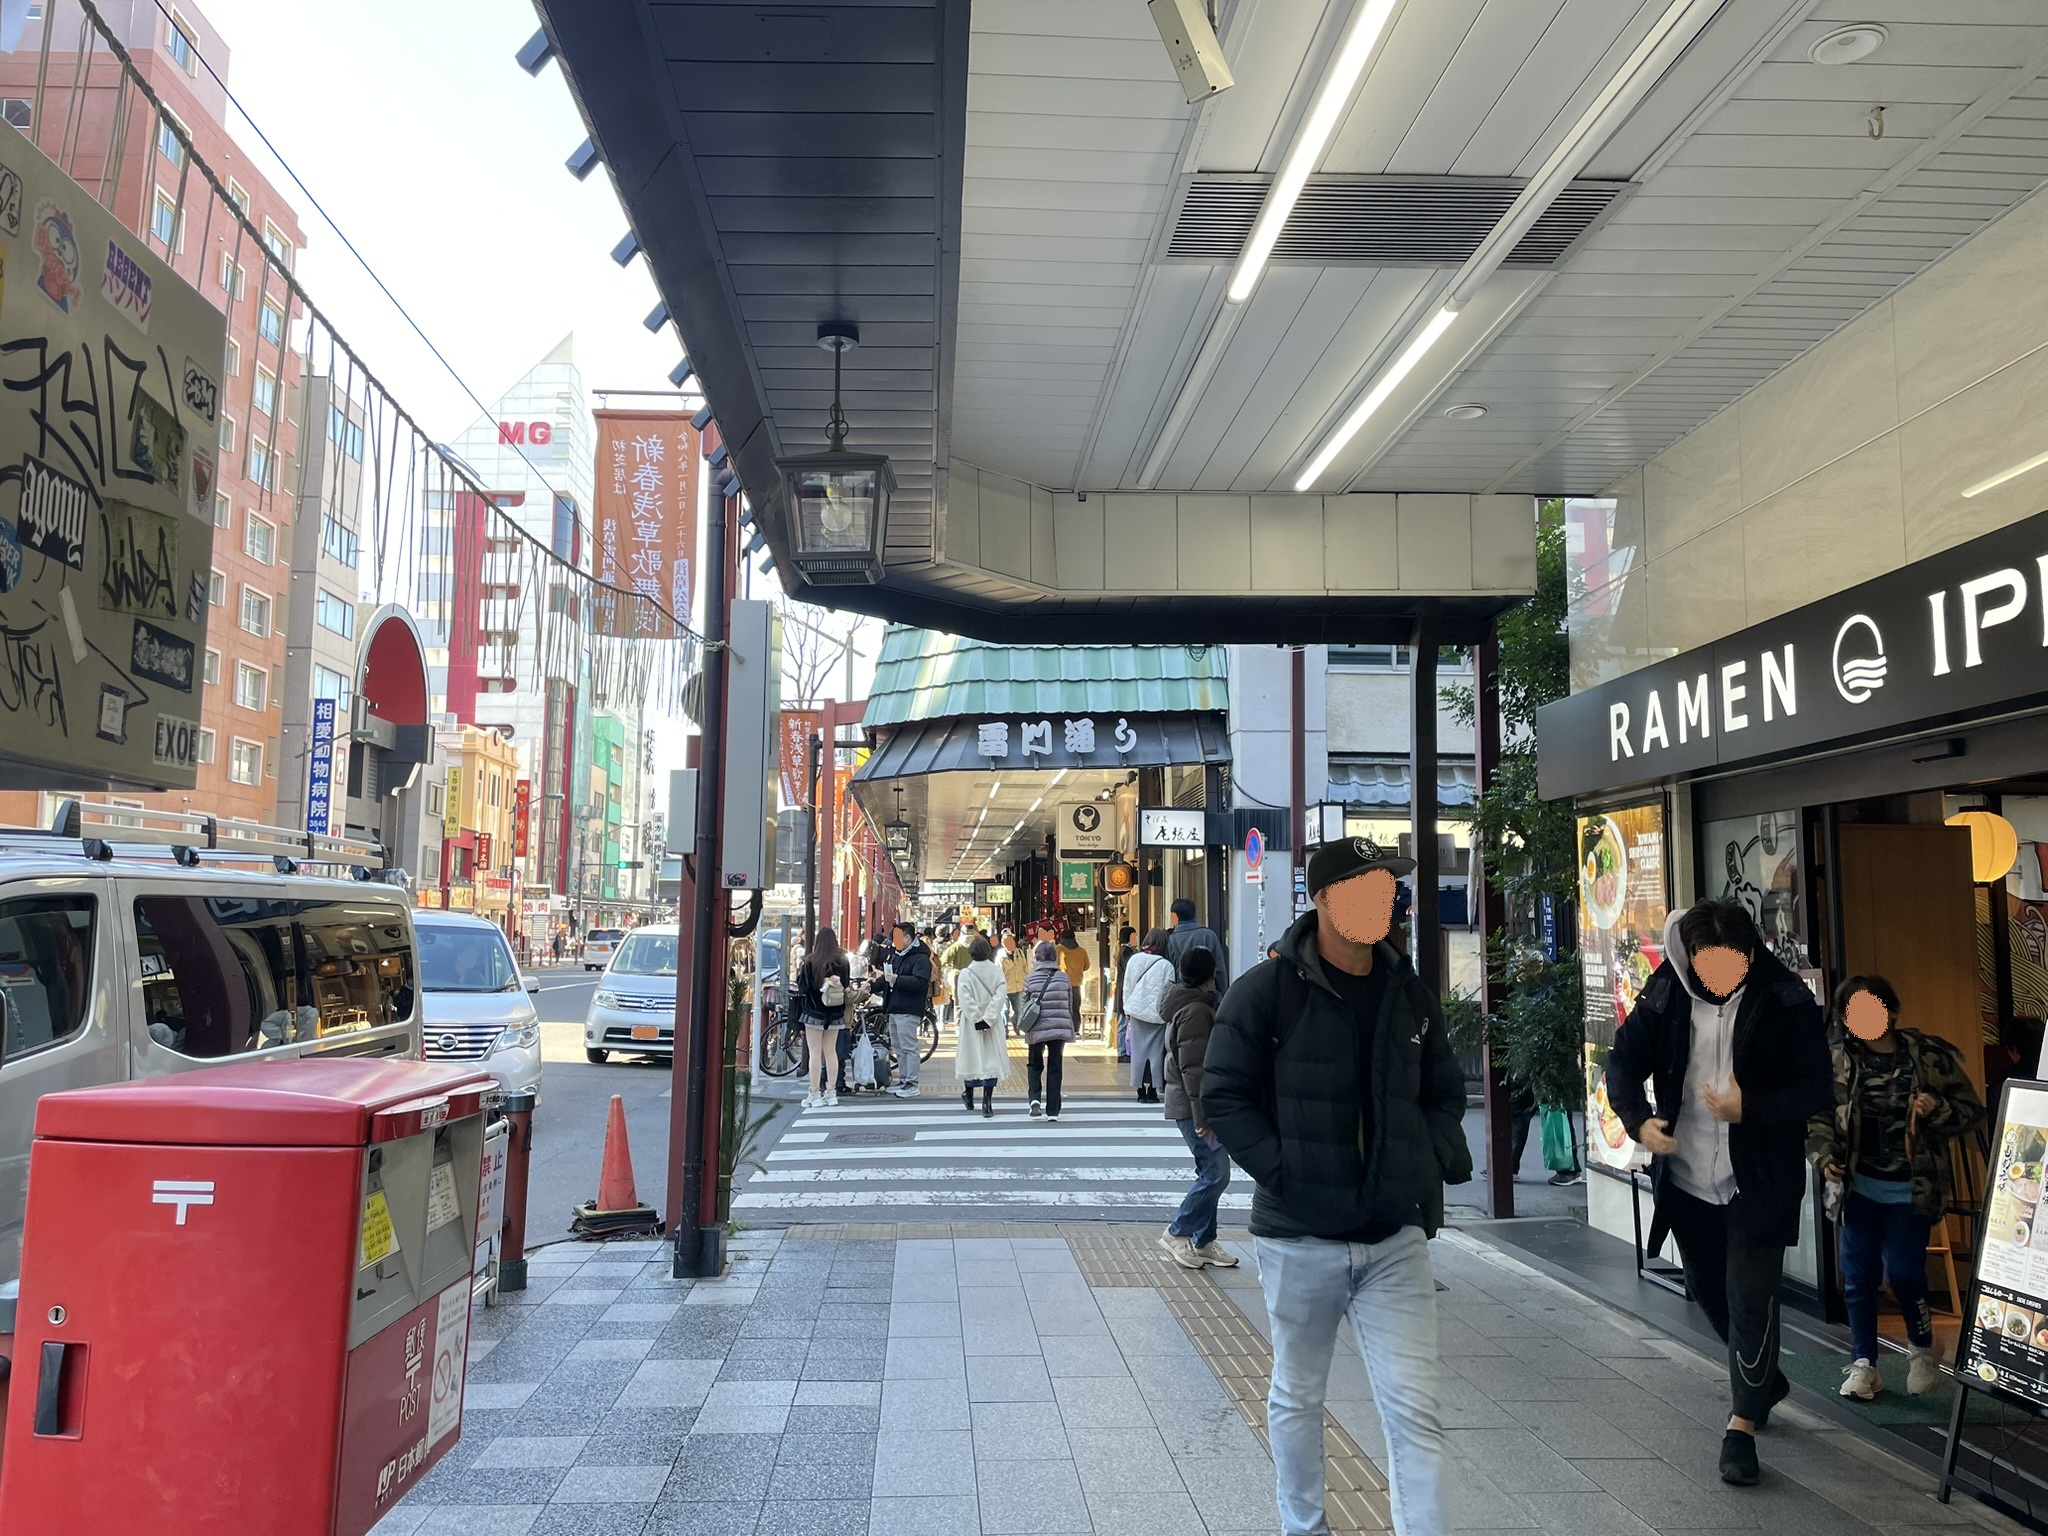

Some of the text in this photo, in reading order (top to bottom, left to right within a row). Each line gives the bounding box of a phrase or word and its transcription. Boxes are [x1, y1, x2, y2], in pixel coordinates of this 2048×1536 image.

[498, 421, 551, 445] MG
[1611, 554, 2048, 762] RAMEN IP
[978, 717, 1138, 758] 雷門通り
[308, 702, 333, 818] 相愛動物病院
[1074, 834, 1102, 842] TOKYO
[1154, 825, 1201, 842] 尾張屋
[1640, 857, 1660, 870] CLASSIC
[482, 1149, 503, 1177] 禁止
[405, 1317, 427, 1362] 郵便
[399, 1383, 422, 1427] POST
